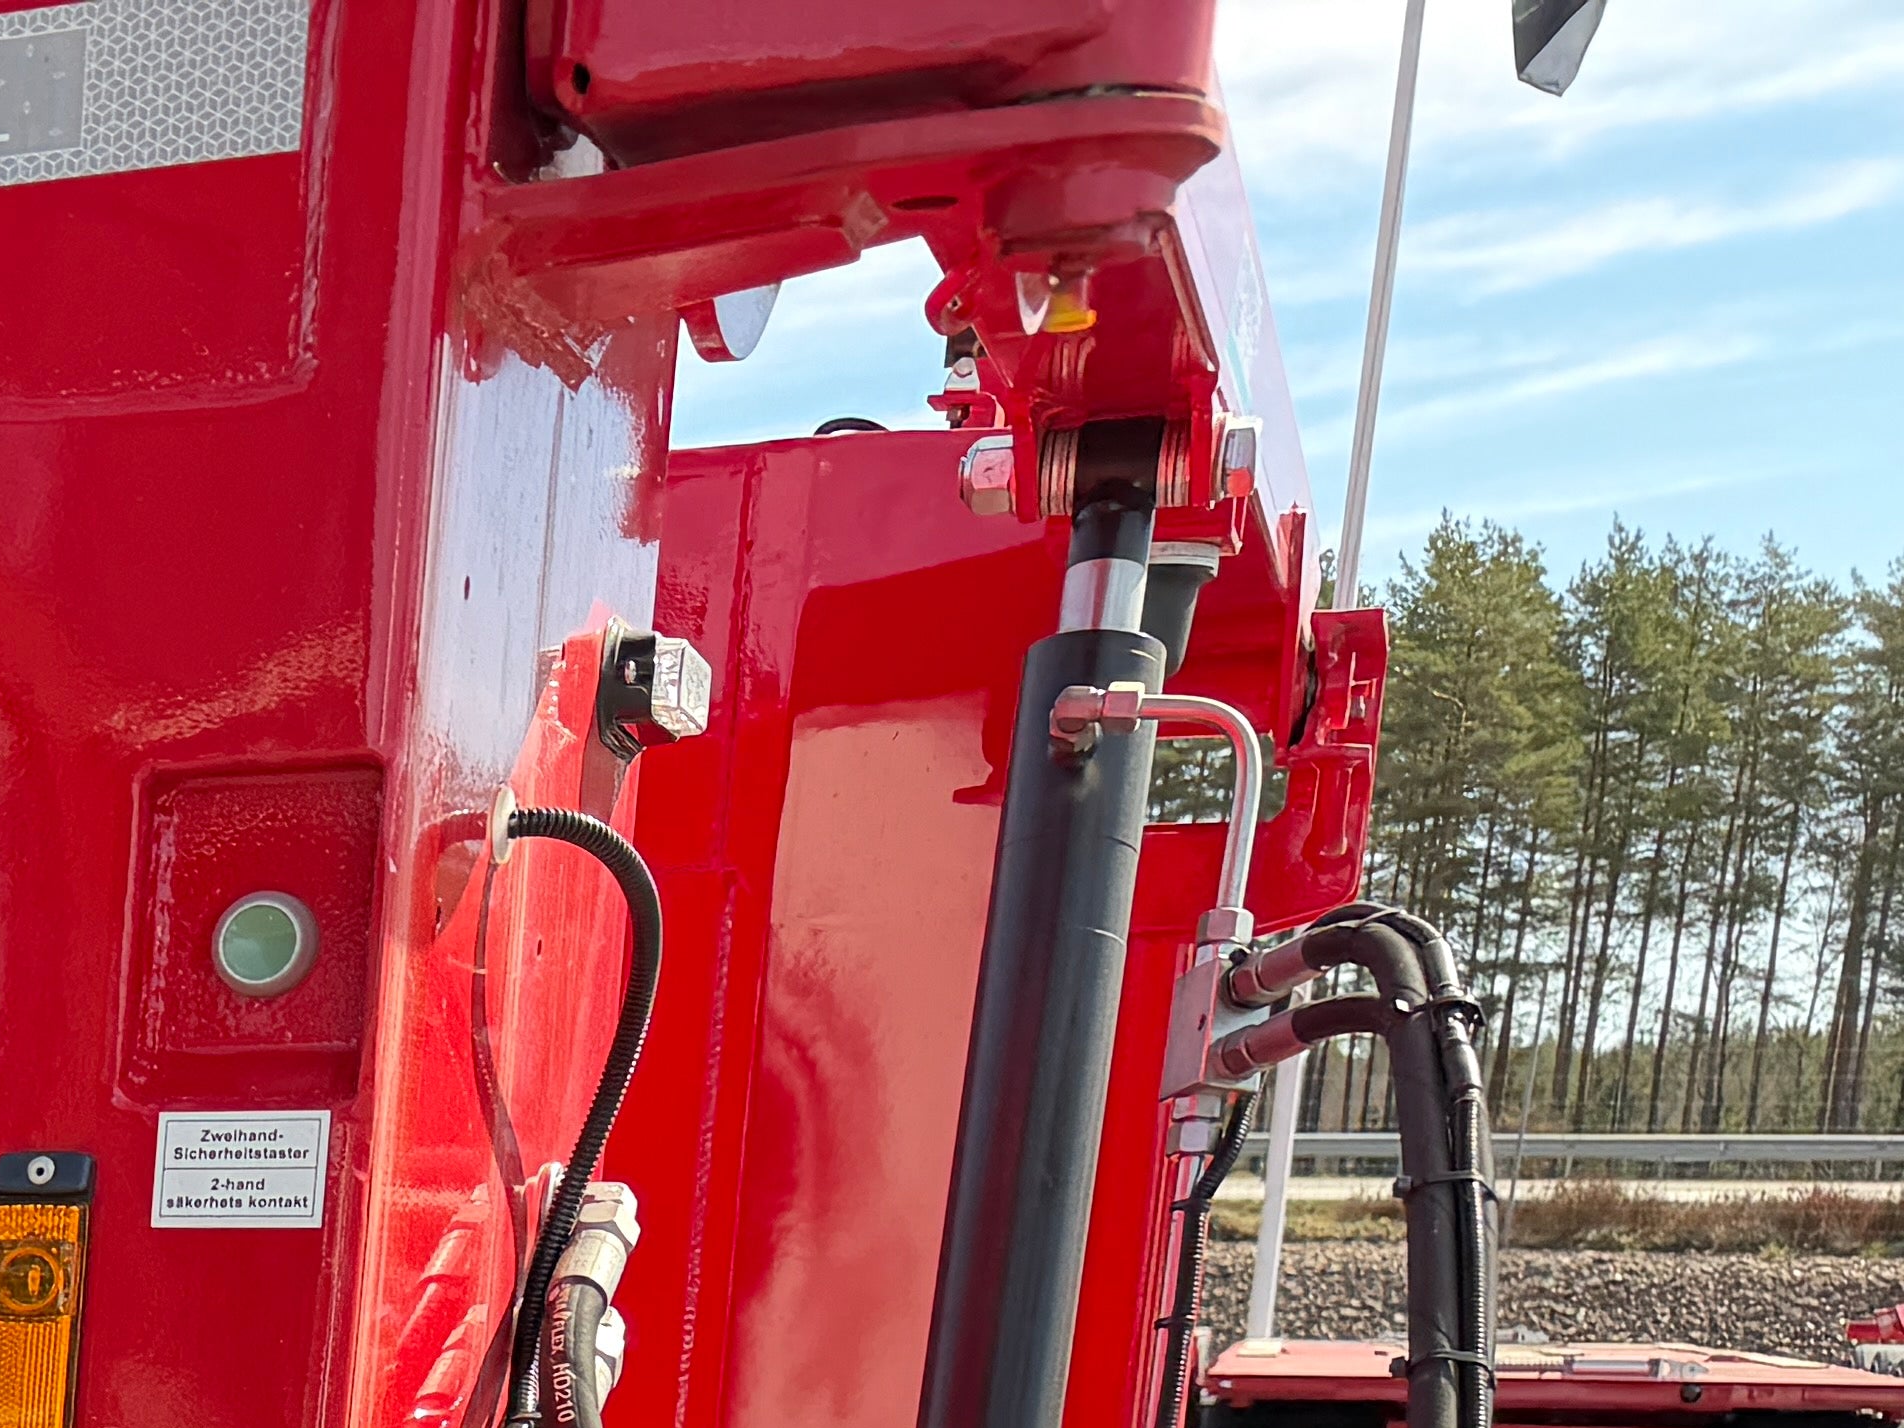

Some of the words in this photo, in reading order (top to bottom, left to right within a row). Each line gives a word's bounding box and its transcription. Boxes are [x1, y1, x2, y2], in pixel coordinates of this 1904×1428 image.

[200, 1129, 284, 1143] Zweihand-
[173, 1147, 310, 1160] Sicherheitstaster
[210, 1178, 265, 1191] 2-hand
[166, 1195, 242, 1209] säkerhets
[248, 1195, 309, 1209] kontakt
